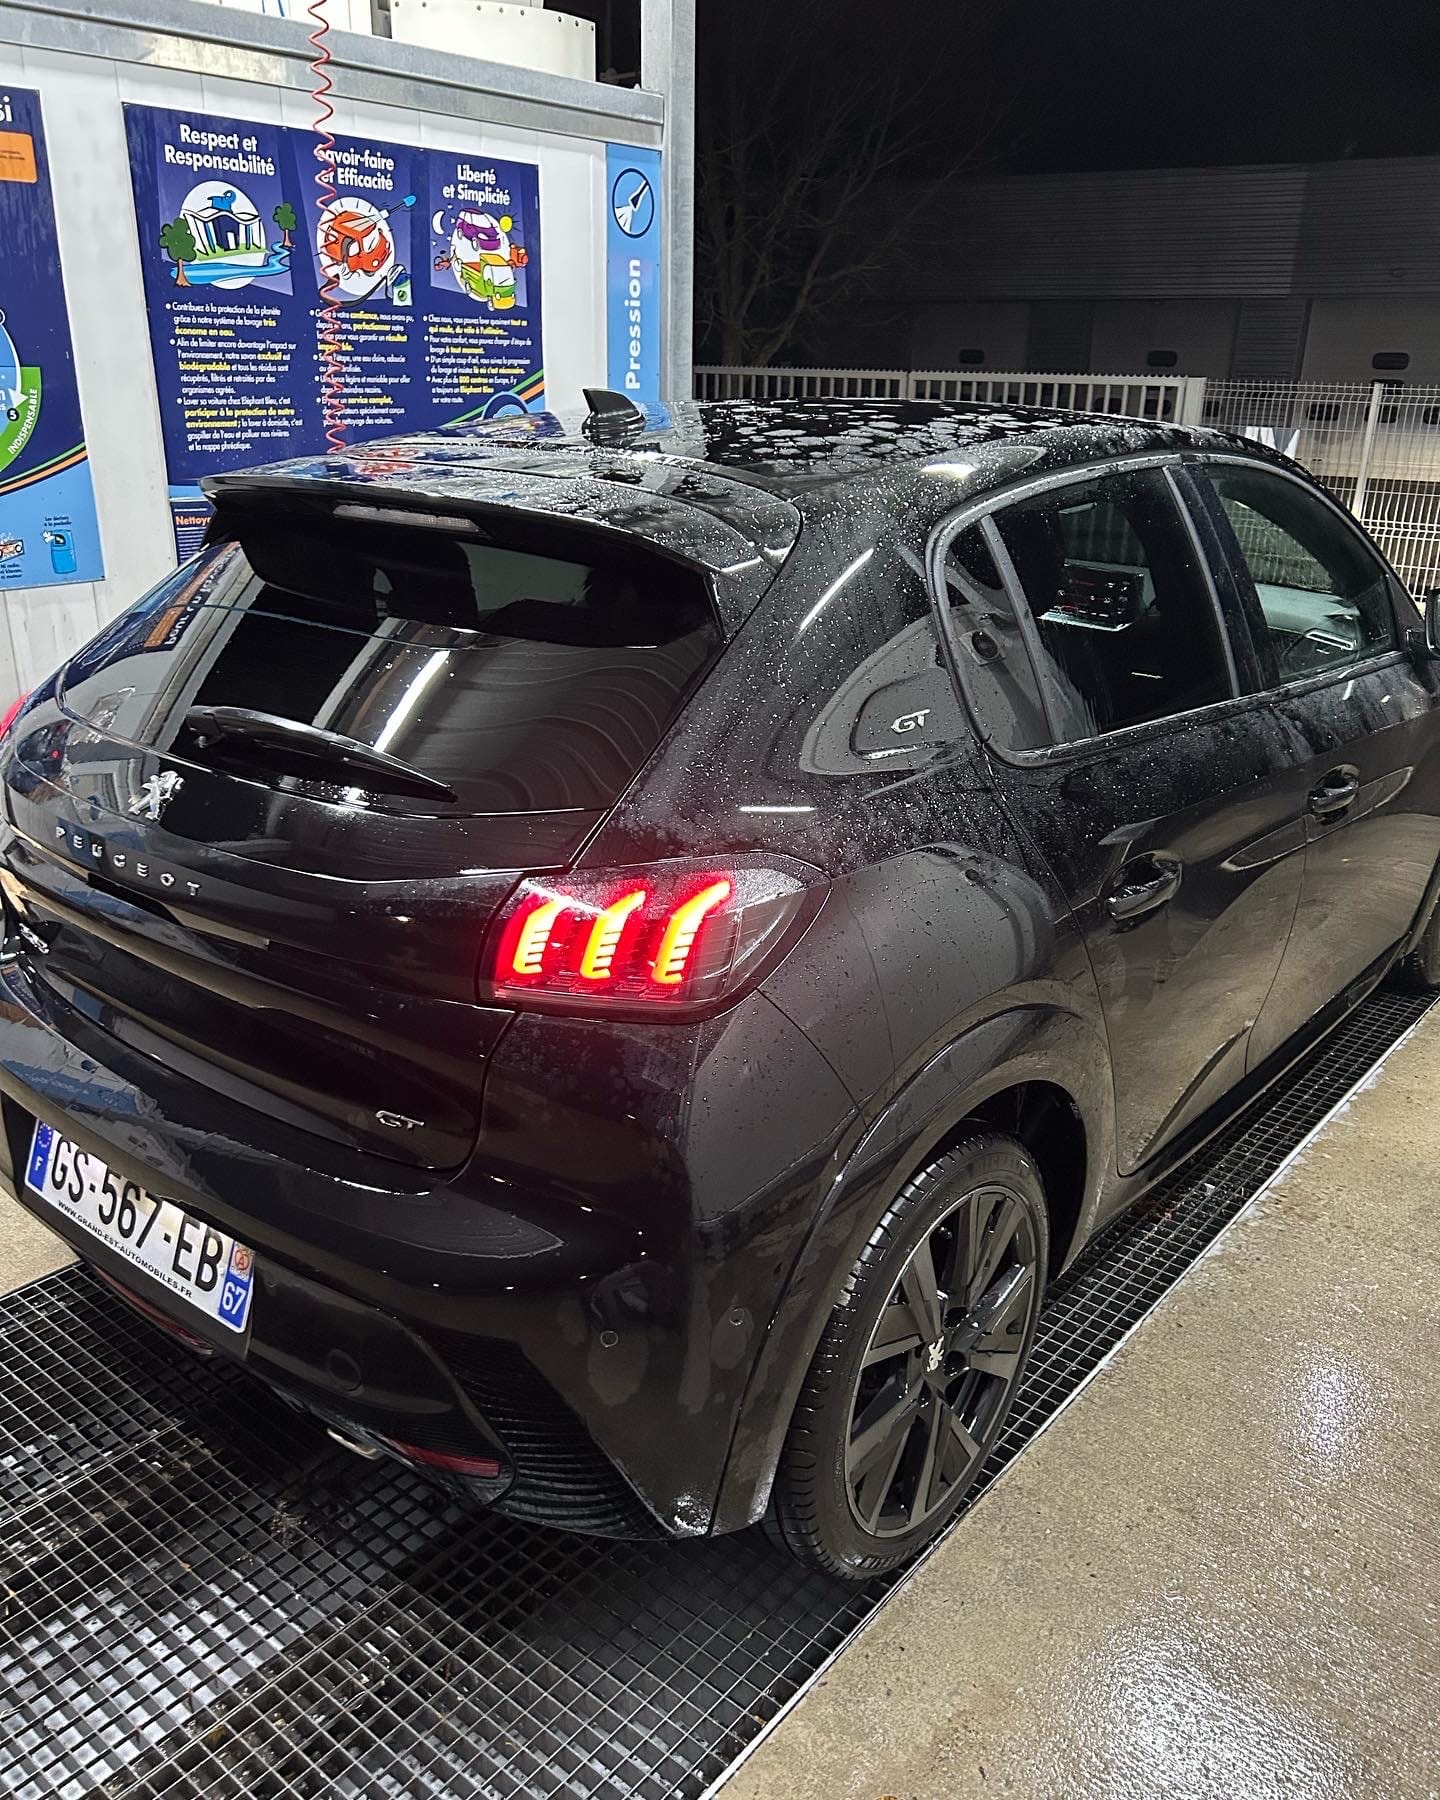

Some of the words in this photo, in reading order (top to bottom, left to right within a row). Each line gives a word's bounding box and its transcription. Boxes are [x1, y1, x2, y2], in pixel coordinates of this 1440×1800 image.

[179, 124, 240, 151] Respect
[242, 135, 257, 152] et
[164, 144, 275, 176] Responsabilité
[337, 167, 393, 191] Efficacité
[457, 164, 496, 184] Liberté
[443, 185, 455, 199] et
[457, 184, 510, 206] Simplicité
[625, 259, 640, 390] Pression
[8, 388, 37, 454] INDISPENSABLE
[10, 410, 17, 420] 5
[176, 516, 211, 526] Nettoy
[891, 709, 930, 732] GT
[55, 826, 201, 896] PEUGEOT
[376, 1110, 424, 1130] GT
[34, 1156, 43, 1171] F
[51, 1136, 224, 1293] GS-567-EB
[221, 1281, 248, 1315] 67
[57, 1200, 193, 1298] WWW.GRAND-EST-AUTOMOBILES.FR
